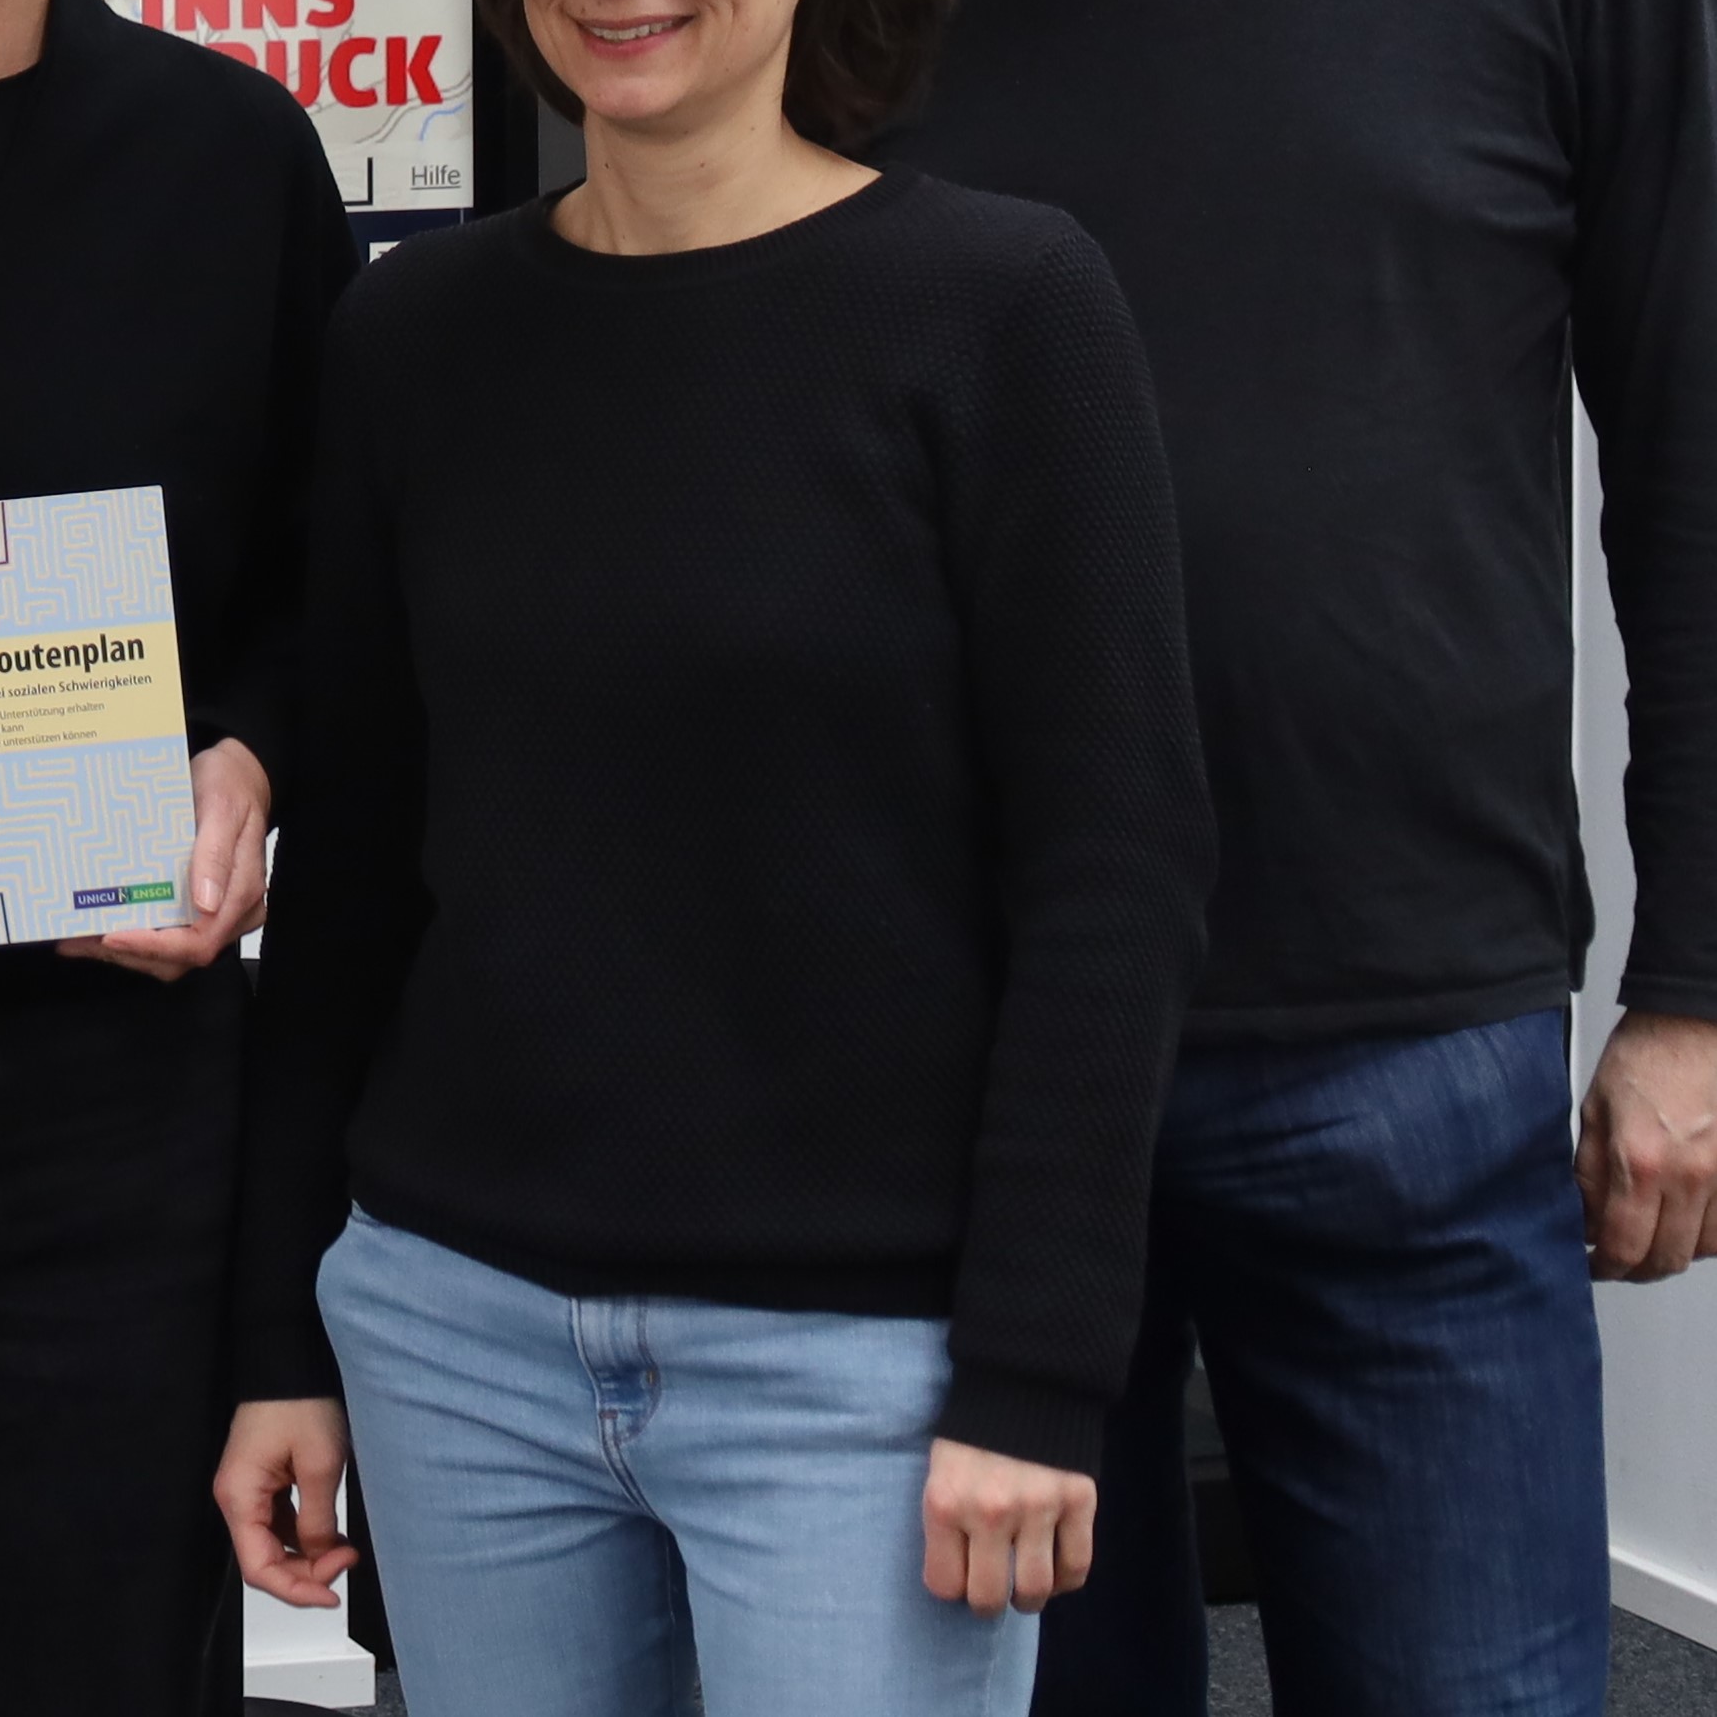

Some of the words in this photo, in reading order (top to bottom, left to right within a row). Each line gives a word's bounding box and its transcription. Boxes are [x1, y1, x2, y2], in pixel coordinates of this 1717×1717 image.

[410, 164, 462, 190] Hilfe
[8, 683, 56, 698] sozialen
[59, 673, 152, 693] Schwierigkeiten
[0, 705, 65, 721] Unterstützung
[67, 701, 106, 714] erhalten
[1, 722, 24, 733] kann
[3, 733, 61, 747] unterstützen
[63, 729, 98, 741] können
